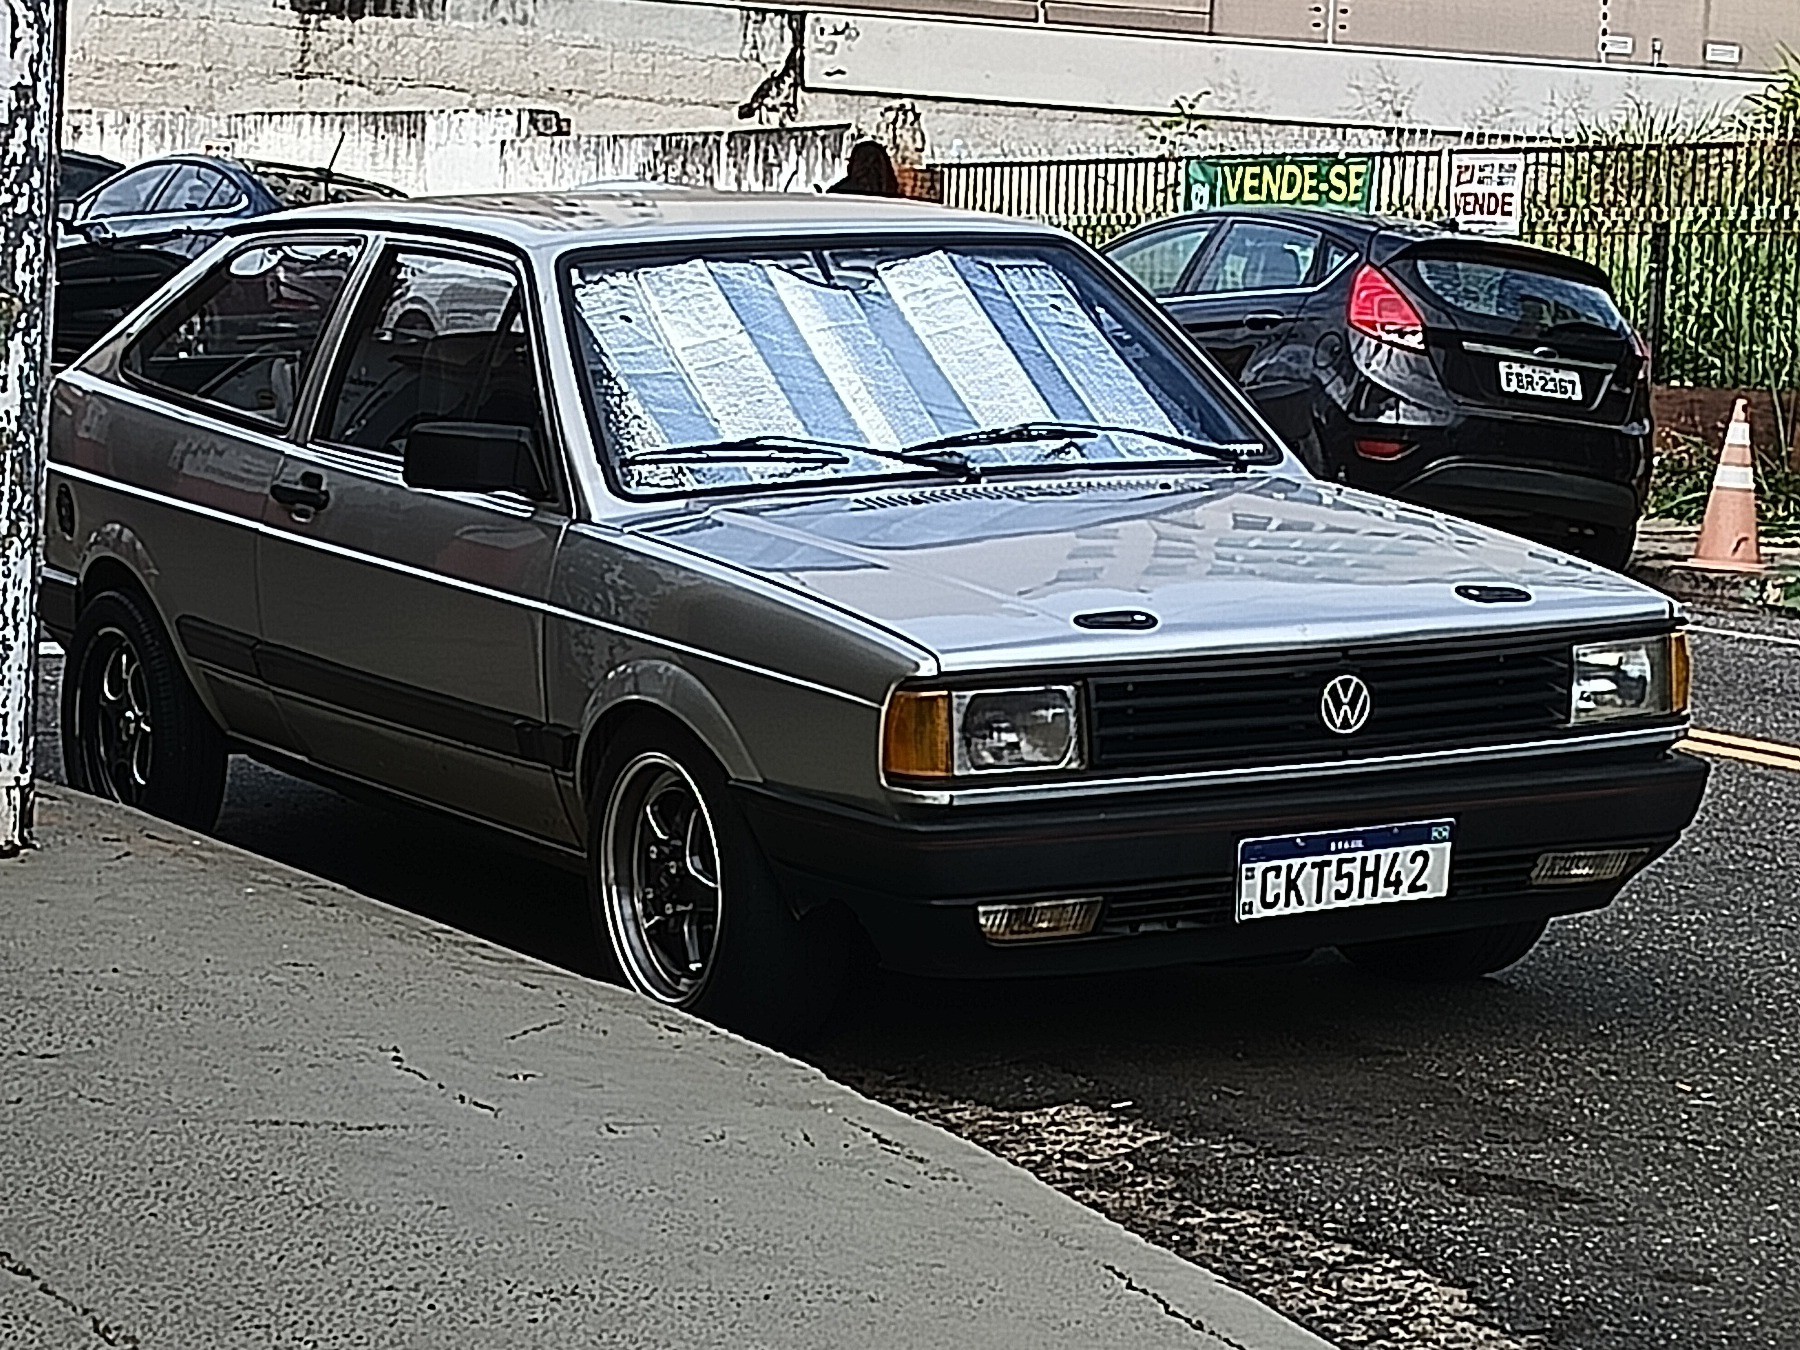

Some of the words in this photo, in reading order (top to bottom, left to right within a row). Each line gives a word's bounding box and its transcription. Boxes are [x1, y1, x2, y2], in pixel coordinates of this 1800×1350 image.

[1224, 164, 1367, 203] VENDE-SE
[1454, 192, 1514, 217] VENDE
[1321, 674, 1370, 734] VW
[1259, 849, 1430, 910] CKT5H42
